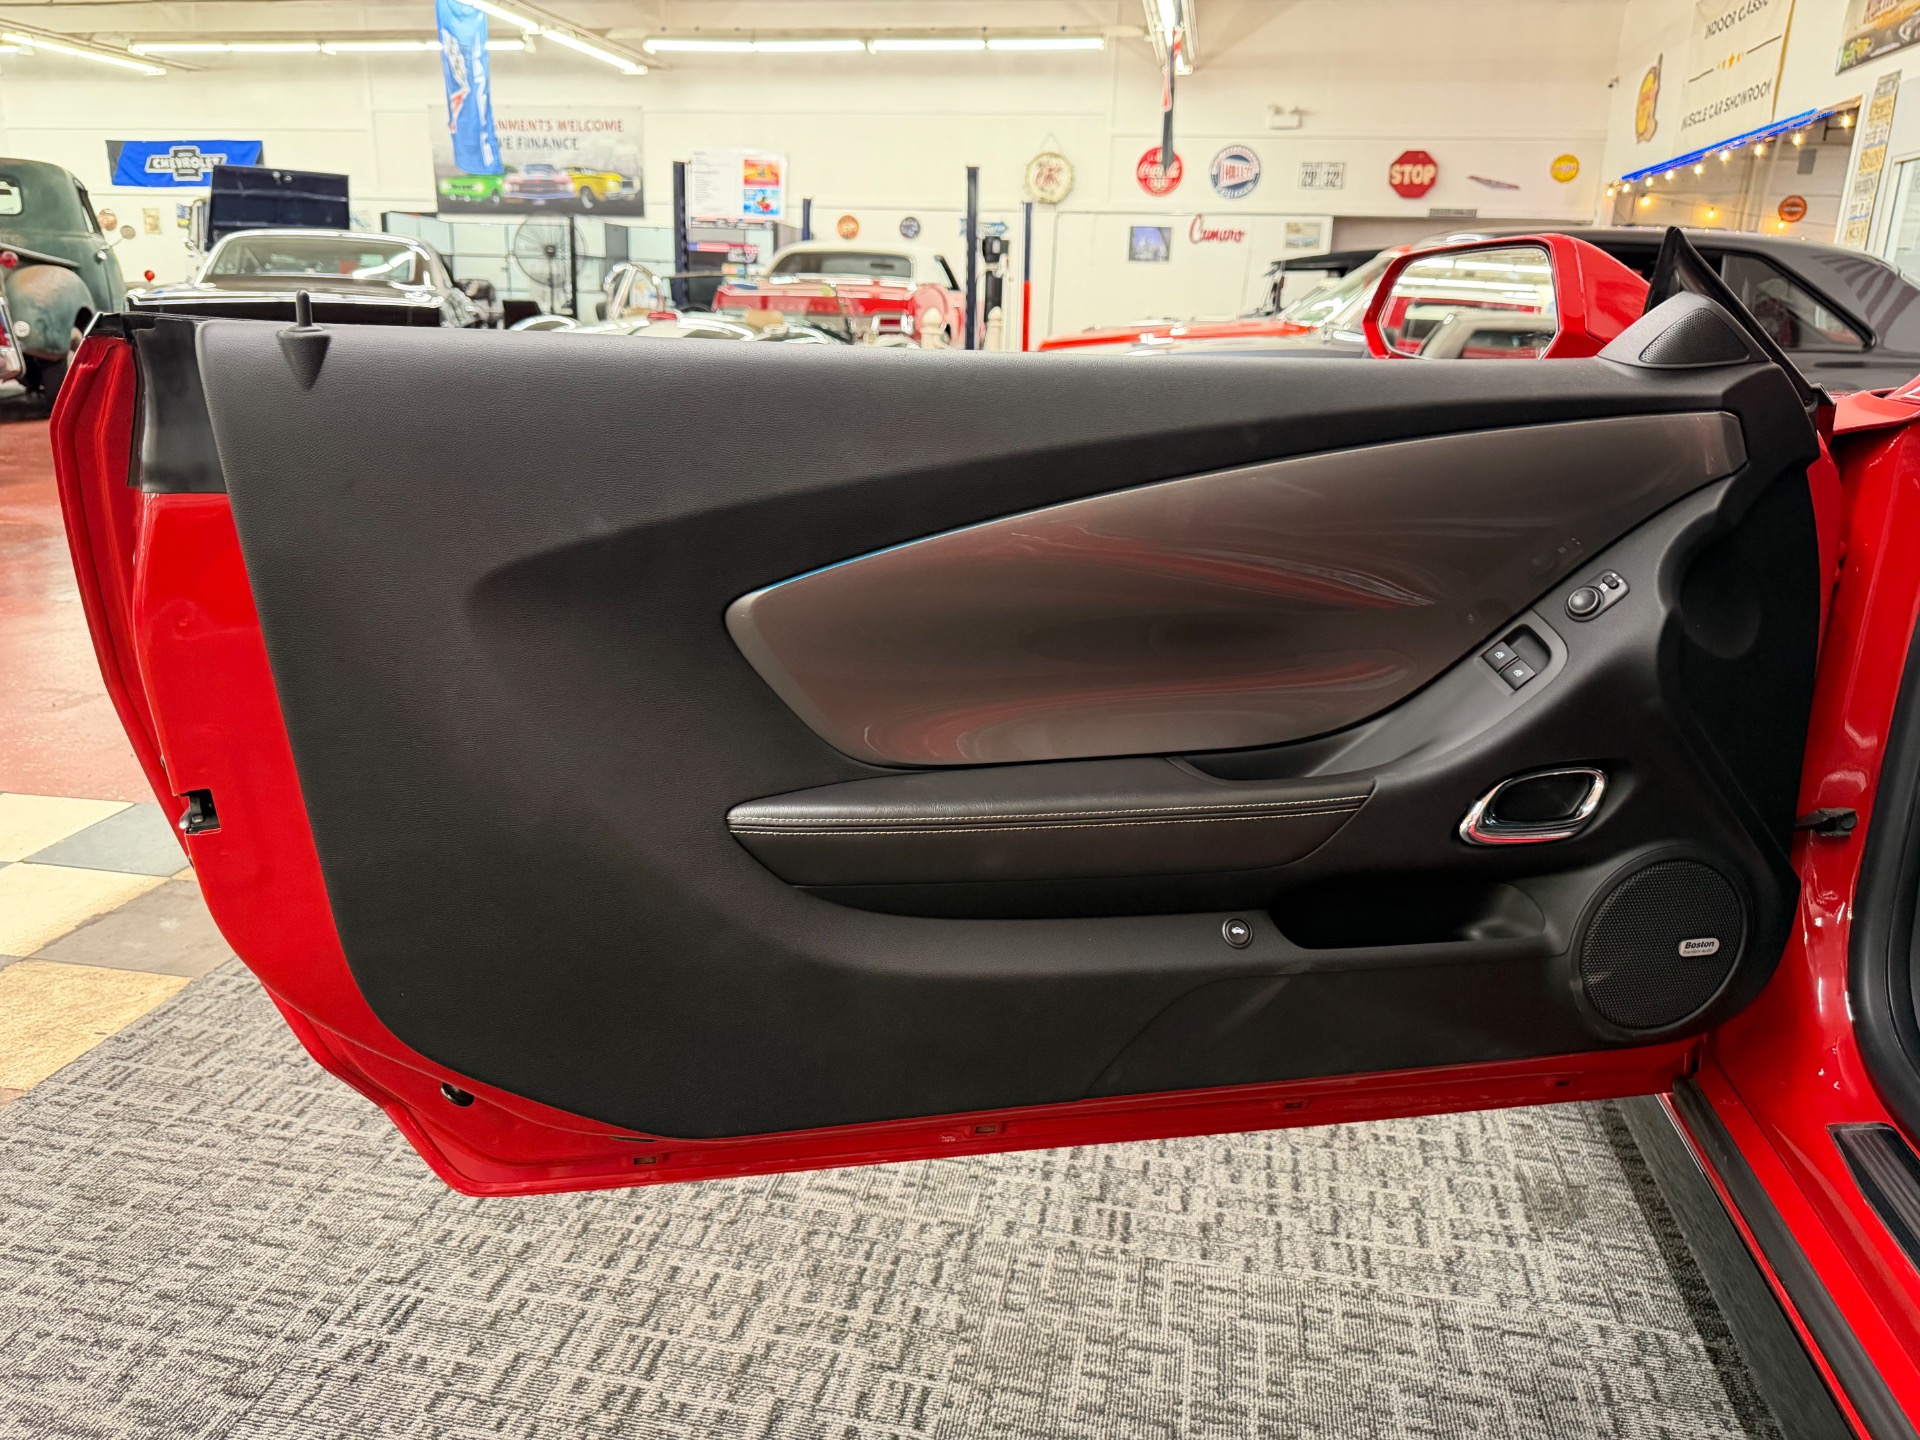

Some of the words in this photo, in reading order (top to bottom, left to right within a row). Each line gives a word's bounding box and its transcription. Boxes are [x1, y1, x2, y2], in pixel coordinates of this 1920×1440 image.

[556, 120, 624, 132] WELCOME
[518, 136, 580, 150] FINANCE
[1389, 164, 1437, 185] STOP
[1684, 941, 1715, 949] Boston
